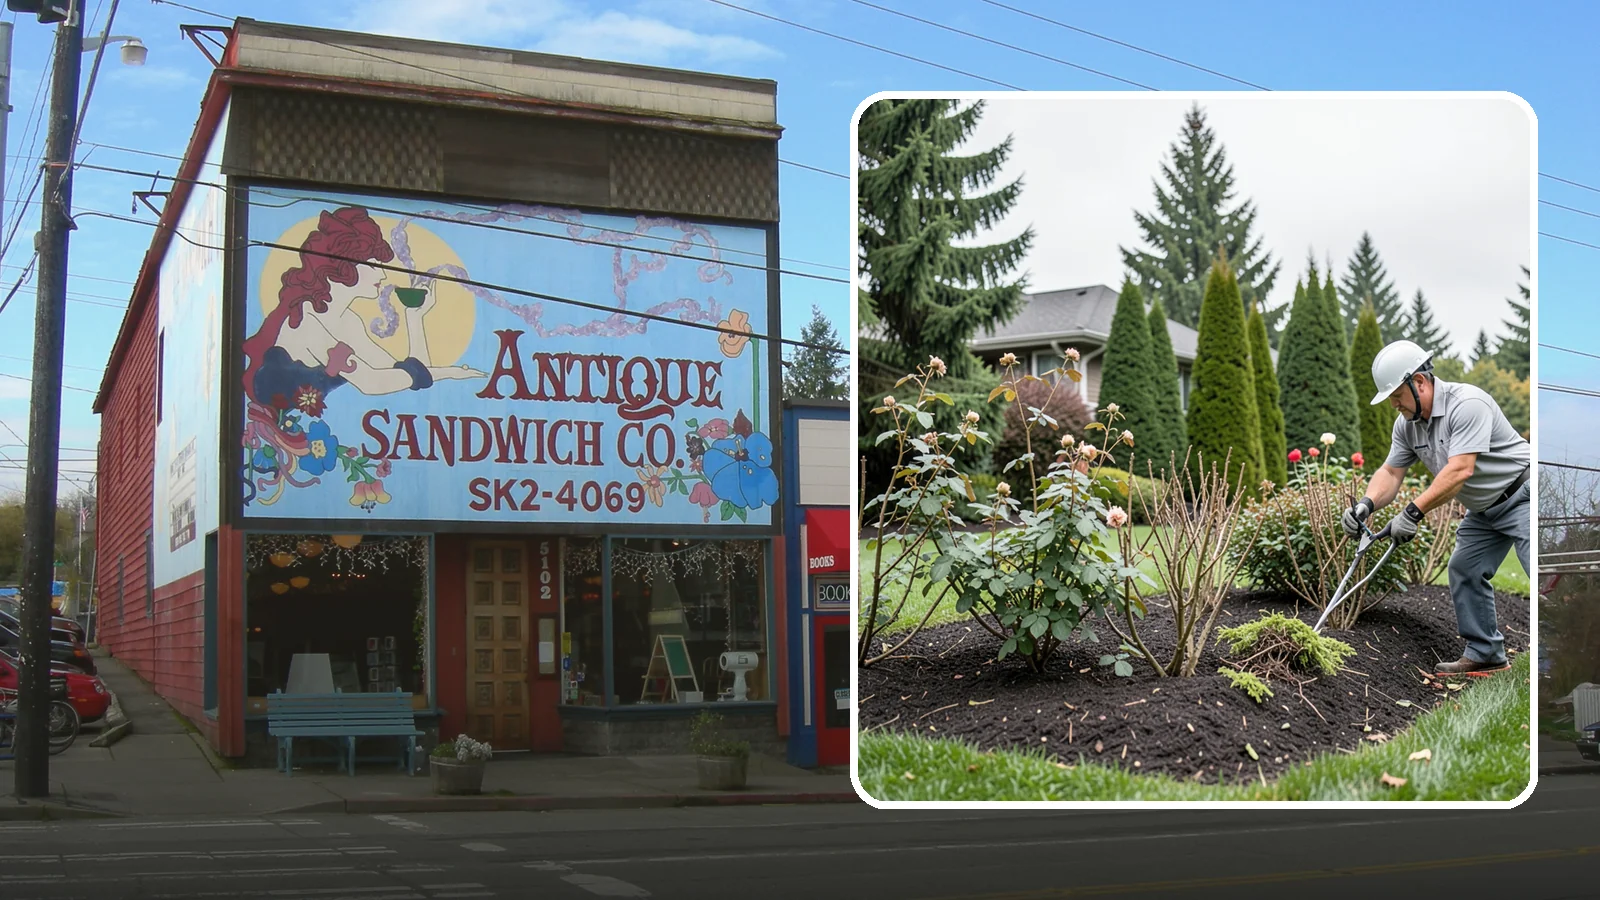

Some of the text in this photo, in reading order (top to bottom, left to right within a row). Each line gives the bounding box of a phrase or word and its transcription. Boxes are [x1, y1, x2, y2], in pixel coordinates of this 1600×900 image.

[476, 328, 724, 421] ANTIQUE
[361, 408, 685, 469] SANDWICH CO.
[468, 477, 646, 514] SK2-4069
[540, 541, 552, 600] 5102
[809, 555, 835, 569] BOOKS
